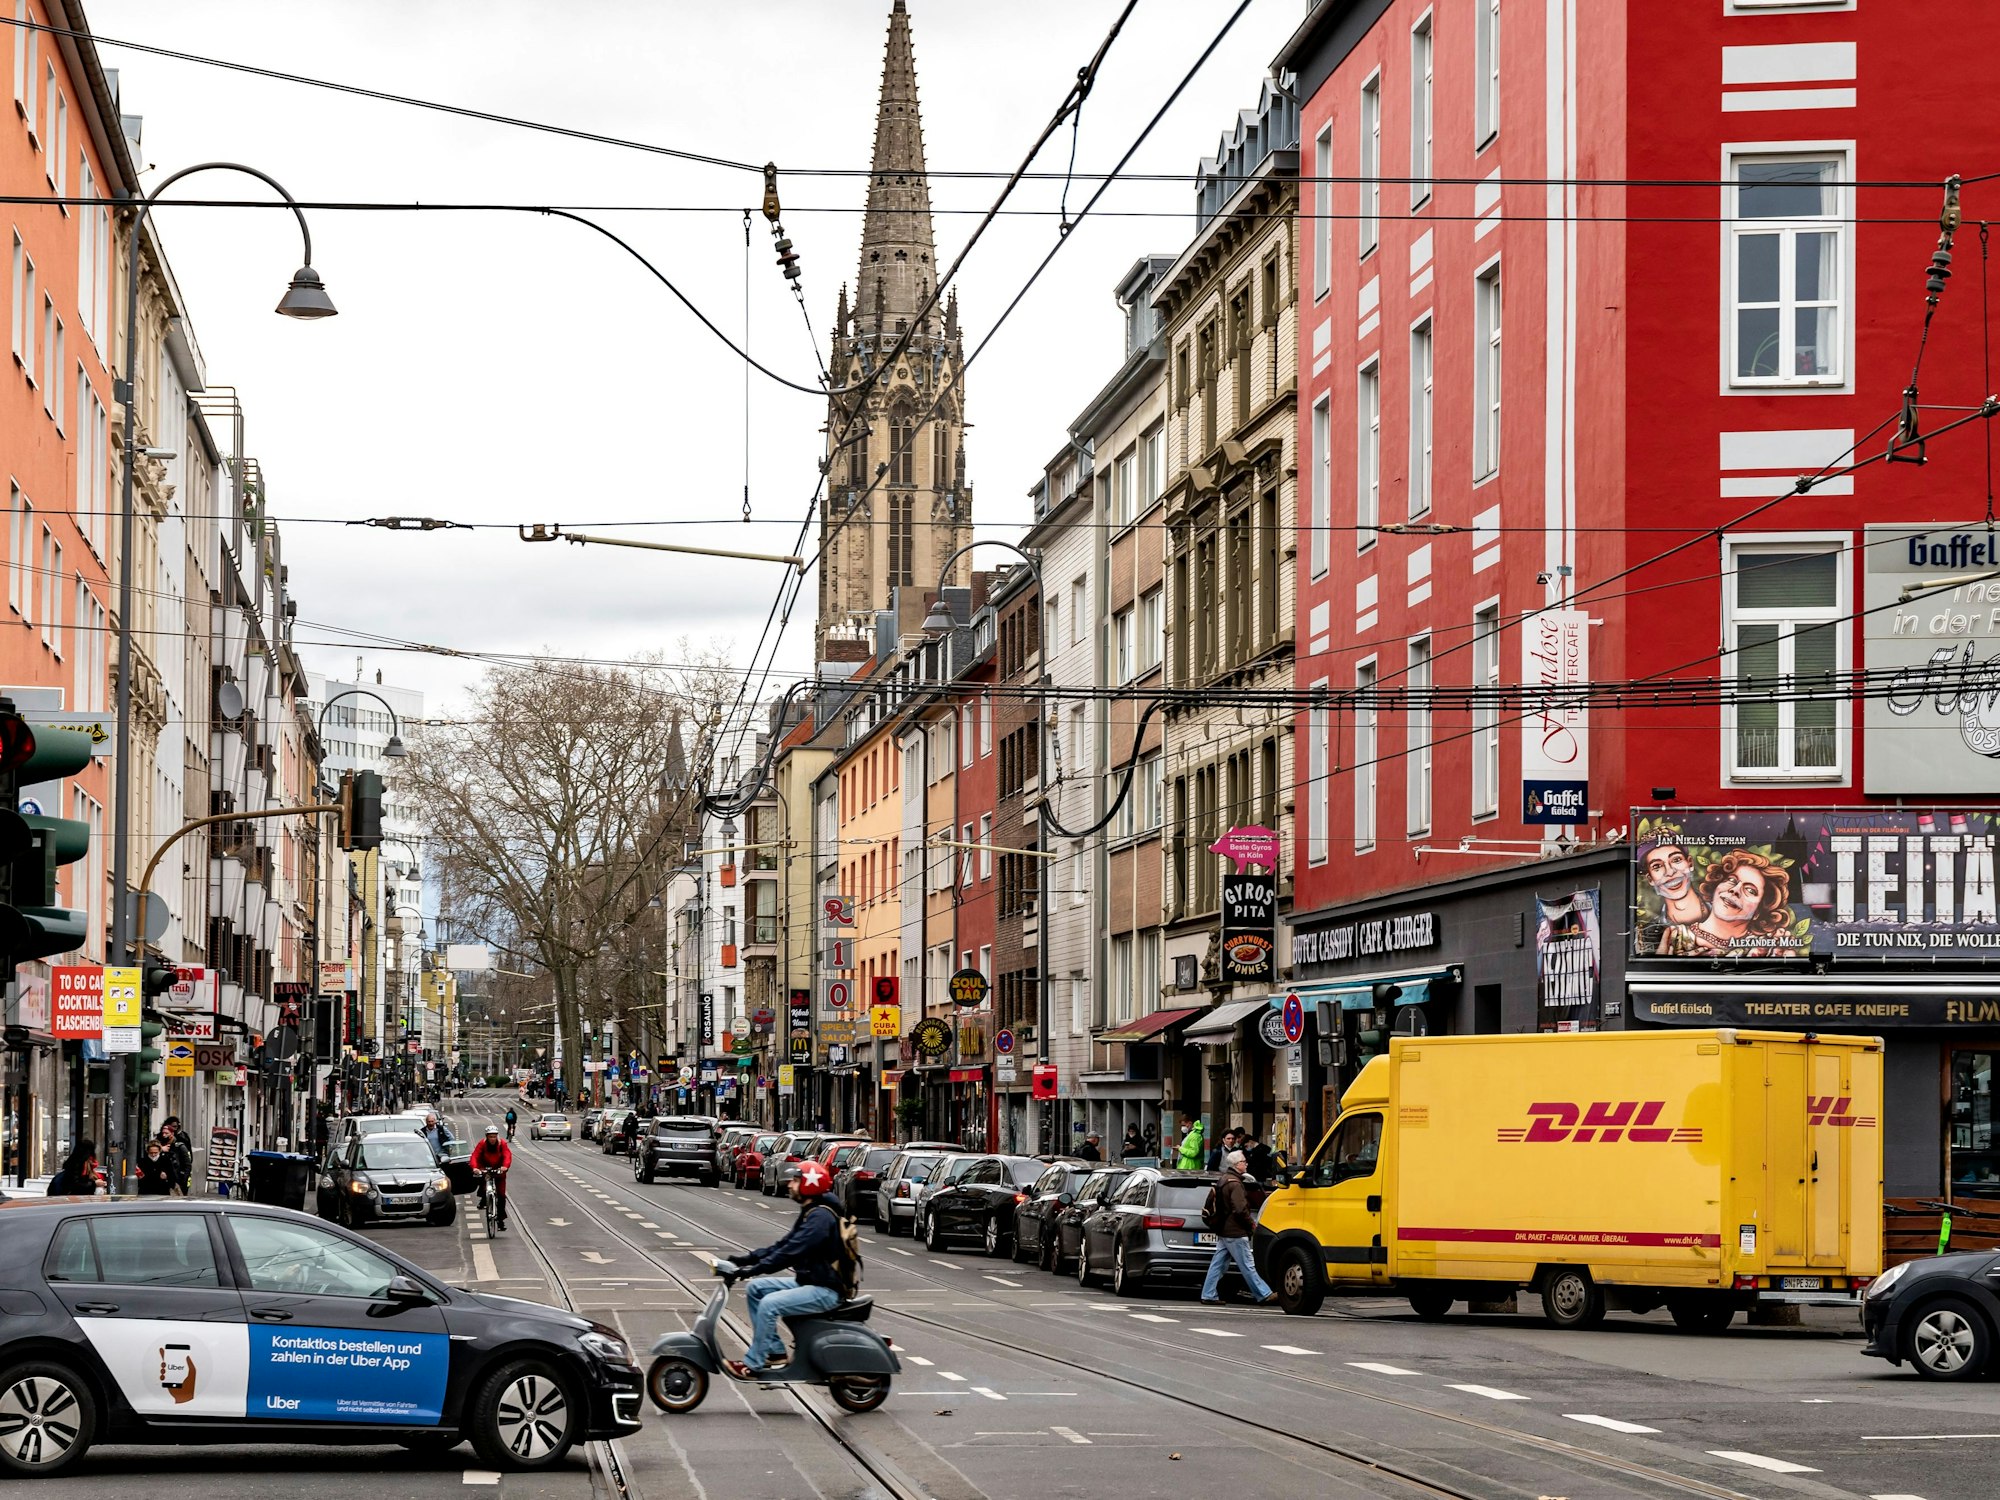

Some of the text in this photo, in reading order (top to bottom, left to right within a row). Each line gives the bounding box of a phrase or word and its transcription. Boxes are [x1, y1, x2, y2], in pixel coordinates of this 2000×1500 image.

[1909, 533, 1999, 568] Gaffel
[1893, 608, 1919, 634] in
[1929, 608, 1981, 634] der
[1543, 790, 1585, 806] Gaffel
[1551, 806, 1577, 816] Kölsch
[1656, 834, 1746, 847] JAN NIKLAS STEPHAN
[1230, 843, 1273, 852] Beste Gyros
[1247, 851, 1264, 859] Köln
[1225, 882, 1275, 906] GYROS
[1234, 905, 1266, 918] PITA
[1224, 935, 1274, 952] CURRYWURST
[1293, 933, 1317, 964] BUTCH
[1319, 926, 1354, 962] CASSIDY
[1359, 921, 1383, 955] CAFE
[1393, 912, 1434, 949] BURGER
[1728, 937, 1804, 948] ALEXANDER MOLL
[1836, 933, 1861, 947] DIE
[1863, 933, 1896, 947] TUN
[1896, 933, 1927, 950] NIX,
[1929, 933, 1954, 947] DIE
[1227, 960, 1269, 975] POMMES
[60, 975, 71, 990] TO
[74, 974, 86, 990] GO
[952, 977, 985, 989] SOUL
[956, 989, 981, 1000] BAR
[1650, 1002, 1713, 1015] Gaffel Kölsch
[1745, 1003, 1909, 1016] THEATER CAFE KNEIPE
[821, 1023, 845, 1031] SPIEL
[1523, 1101, 1675, 1143] DHL
[1201, 1234, 1207, 1242] K
[1515, 1233, 1527, 1241] DHL
[1527, 1233, 1547, 1241] PAKET
[1551, 1234, 1577, 1242] EINFACH.
[1578, 1234, 1600, 1242] IMMER.
[1601, 1233, 1629, 1243] ÜBERALL.
[1664, 1236, 1702, 1245] www.dhl.de
[271, 1335, 422, 1355] Kontaktlos bestellen und
[270, 1351, 411, 1371] zahlen in der Uber App
[266, 1395, 301, 1410] Uber
[380, 1407, 410, 1415] Beförderer.
